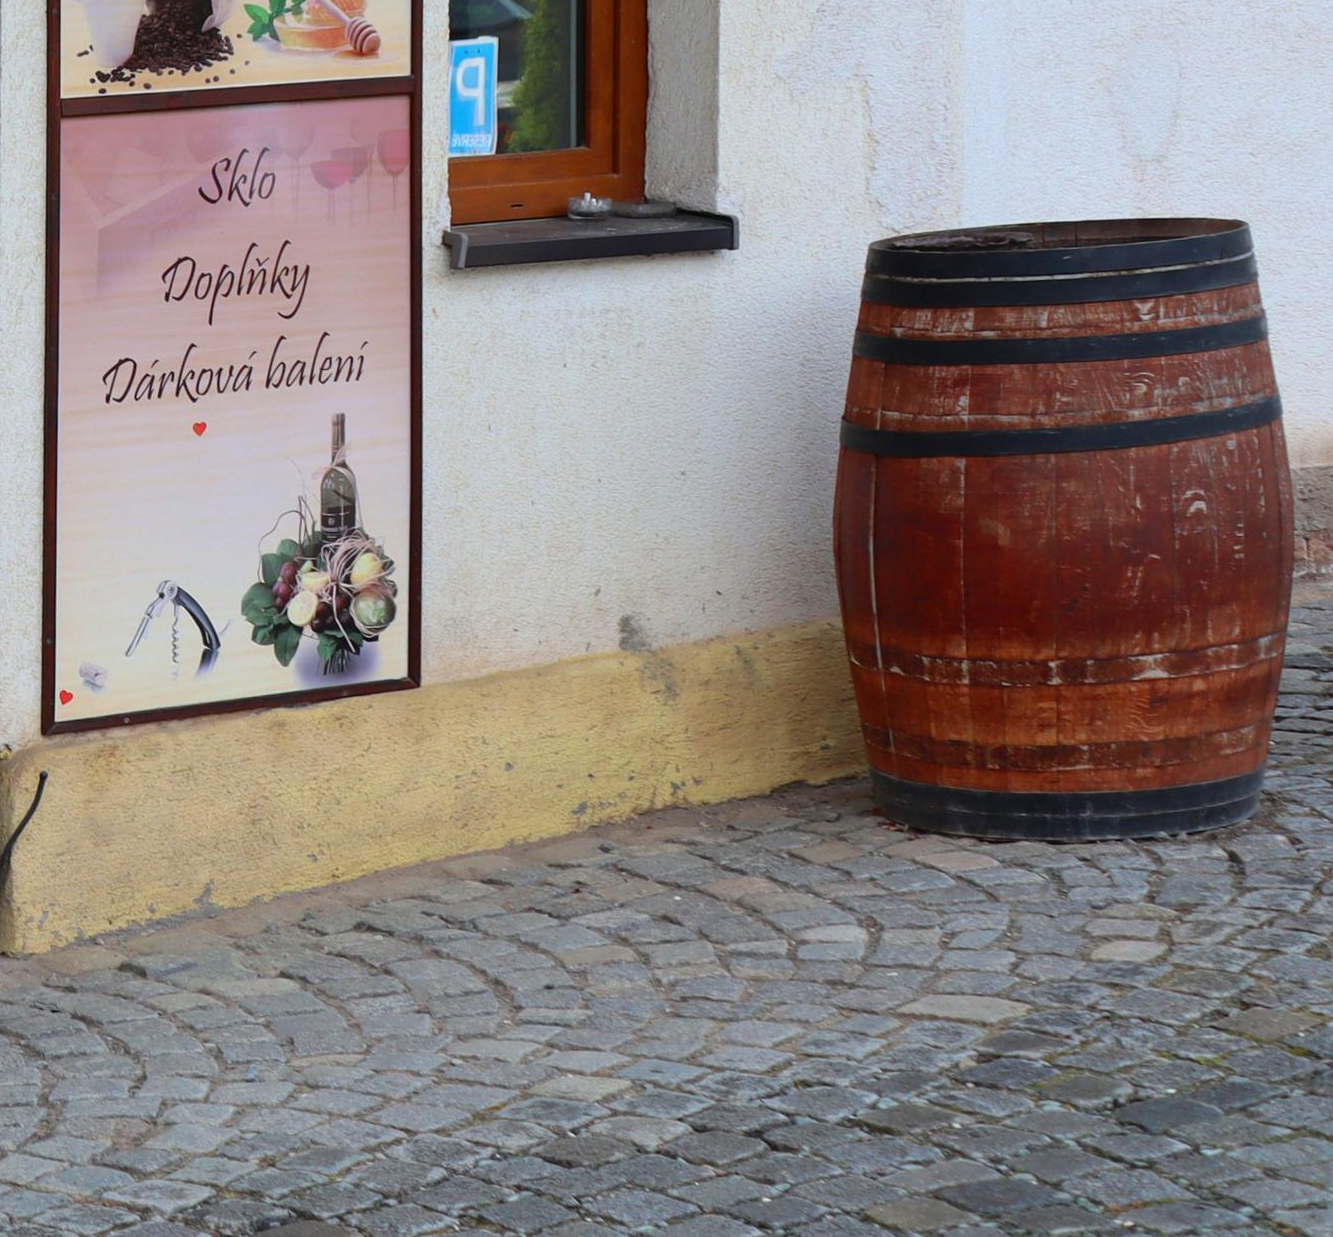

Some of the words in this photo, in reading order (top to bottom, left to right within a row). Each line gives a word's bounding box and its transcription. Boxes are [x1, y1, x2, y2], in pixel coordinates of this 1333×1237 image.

[198, 147, 276, 207] Sklo
[161, 240, 310, 326] Doplňky
[102, 343, 258, 405] Dárková
[265, 331, 369, 389] balení
